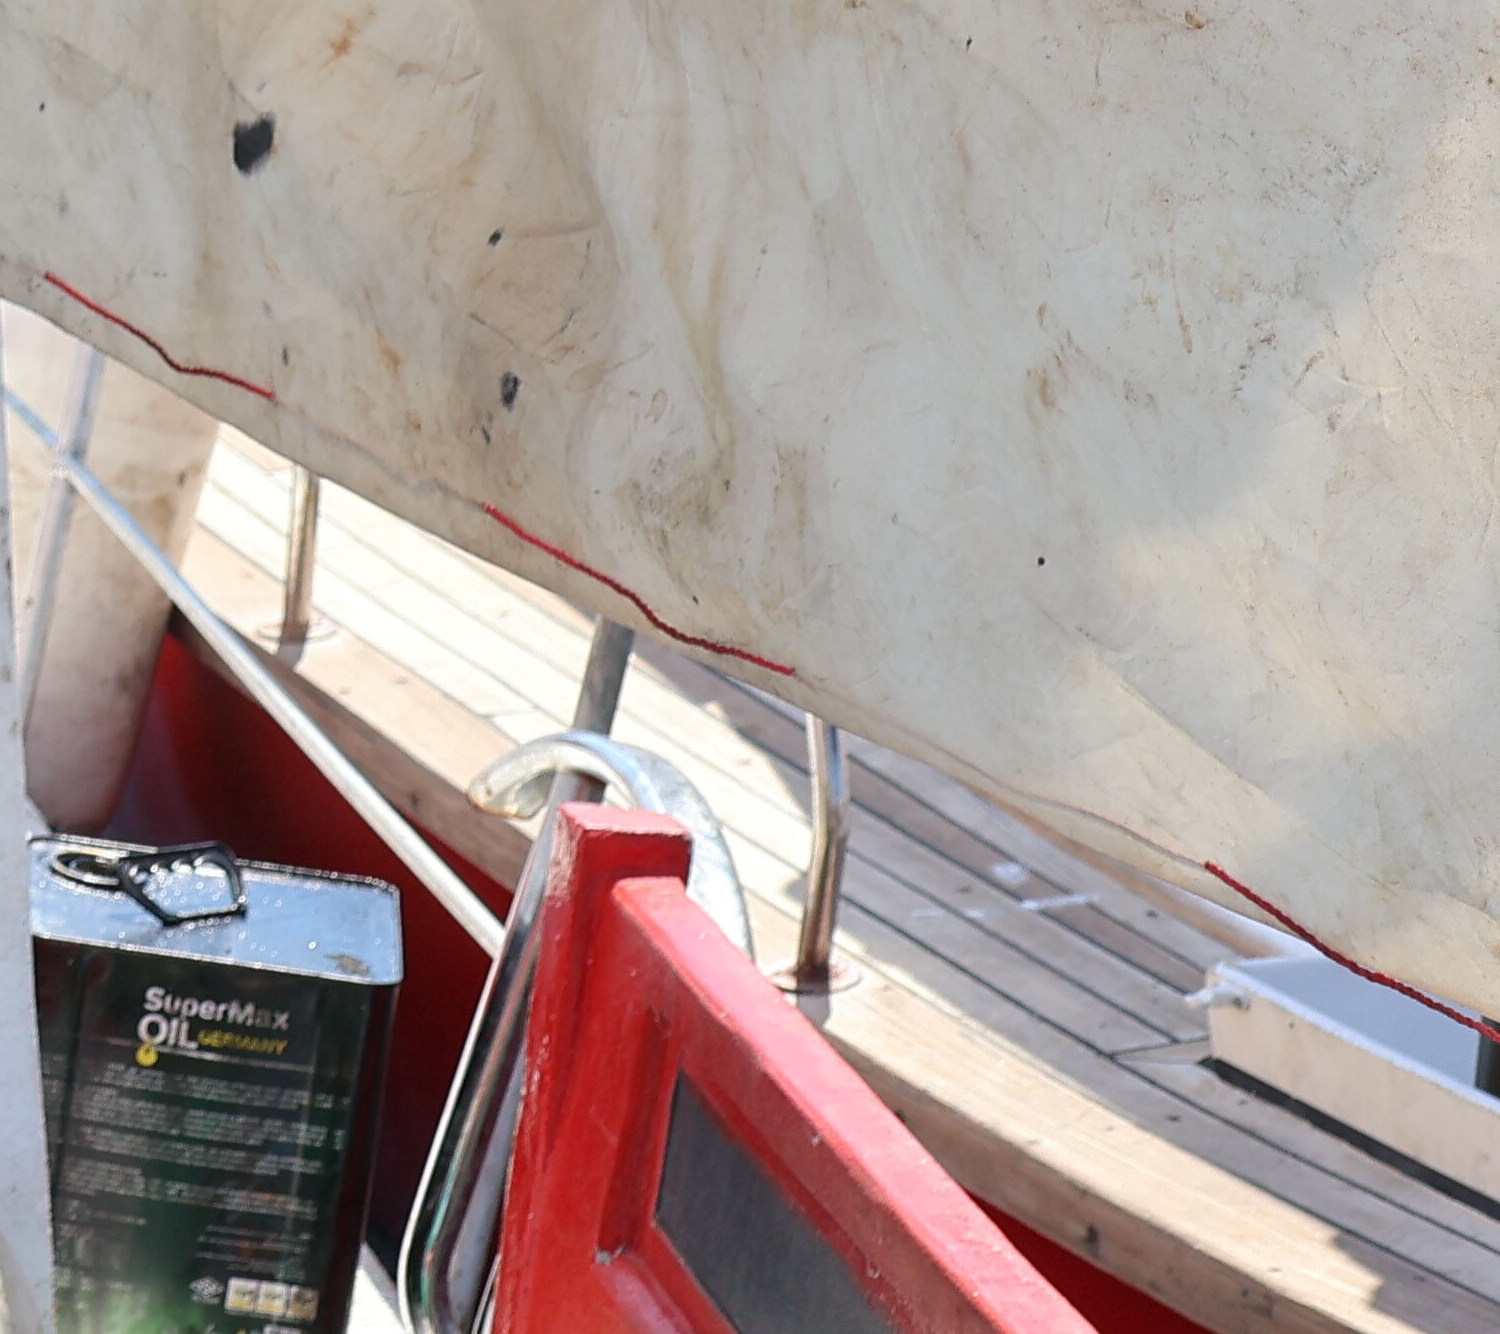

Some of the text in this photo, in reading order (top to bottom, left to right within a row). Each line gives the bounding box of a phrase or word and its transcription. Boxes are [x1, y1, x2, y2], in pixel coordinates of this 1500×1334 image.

[142, 985, 291, 1031] SuperMax
[136, 1011, 289, 1056] OIL GERMANY
